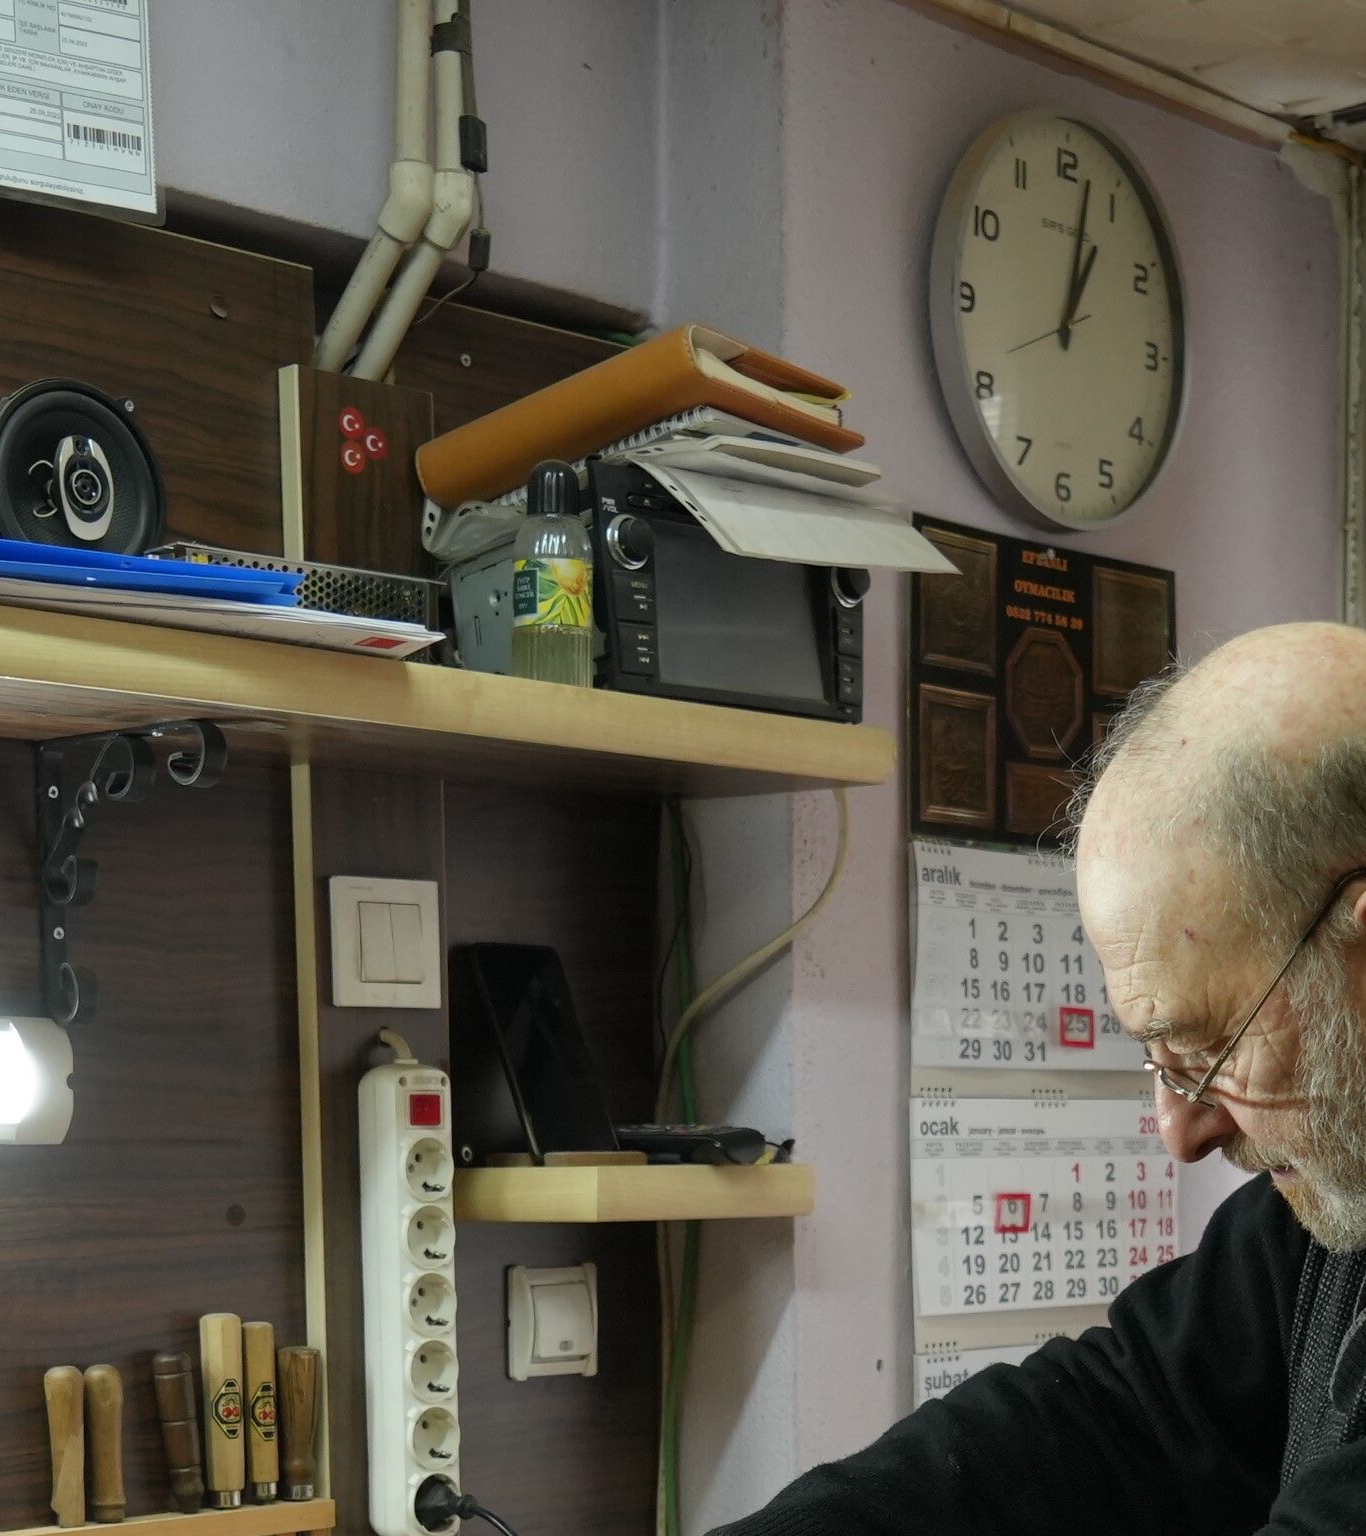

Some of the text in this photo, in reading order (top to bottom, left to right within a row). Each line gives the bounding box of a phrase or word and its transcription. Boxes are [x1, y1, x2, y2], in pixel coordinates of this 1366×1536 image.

[7, 85, 27, 95] EDEN
[1016, 158, 1027, 190] 11
[1057, 147, 1079, 184] 12
[1109, 193, 1116, 223] 1
[975, 205, 1000, 242] 10
[1133, 263, 1149, 295] 2
[959, 281, 975, 313] 9
[1144, 342, 1159, 372] 3
[976, 371, 995, 401] 8
[1128, 417, 1144, 446] 4
[1016, 436, 1032, 466] 7
[1055, 472, 1072, 502] 6
[1099, 459, 1114, 489] 5
[922, 865, 962, 887] aralık
[968, 918, 1084, 945] 1 2 3 4
[970, 948, 1083, 975] 8 9 10 11
[961, 977, 980, 999] 15
[990, 980, 1010, 1002] 16
[1022, 982, 1045, 1003] 17
[1061, 984, 1085, 1004] 18
[1101, 1013, 1121, 1034] 26
[959, 1038, 1047, 1062] 29 30 31
[920, 1116, 960, 1136] ocak
[1072, 1163, 1080, 1183] 1
[1105, 1162, 1115, 1182] 2
[1137, 1162, 1146, 1182] 3
[1165, 1161, 1173, 1180] 4
[972, 1195, 983, 1215] 5
[1039, 1193, 1049, 1213] 7
[1073, 1193, 1082, 1212] 8
[1106, 1191, 1115, 1211] 9
[1128, 1190, 1146, 1209] 10
[1157, 1189, 1173, 1208] 11
[961, 1226, 985, 1246] 12
[1032, 1222, 1051, 1242] 14
[1063, 1221, 1084, 1241] 15
[1096, 1219, 1117, 1239] 16
[1129, 1218, 1147, 1238] 17
[1156, 1217, 1173, 1236] 18
[962, 1255, 986, 1277] 19
[999, 1253, 1020, 1274] 20
[1032, 1251, 1052, 1272] 21
[1065, 1250, 1085, 1270] 22
[1098, 1248, 1118, 1268] 23
[1129, 1246, 1147, 1266] 24
[1156, 1245, 1174, 1264] 25
[964, 1285, 986, 1306] 26
[999, 1283, 1021, 1303] 27
[1032, 1280, 1054, 1300] 28
[1066, 1278, 1086, 1298] 29
[1099, 1276, 1119, 1296] 30
